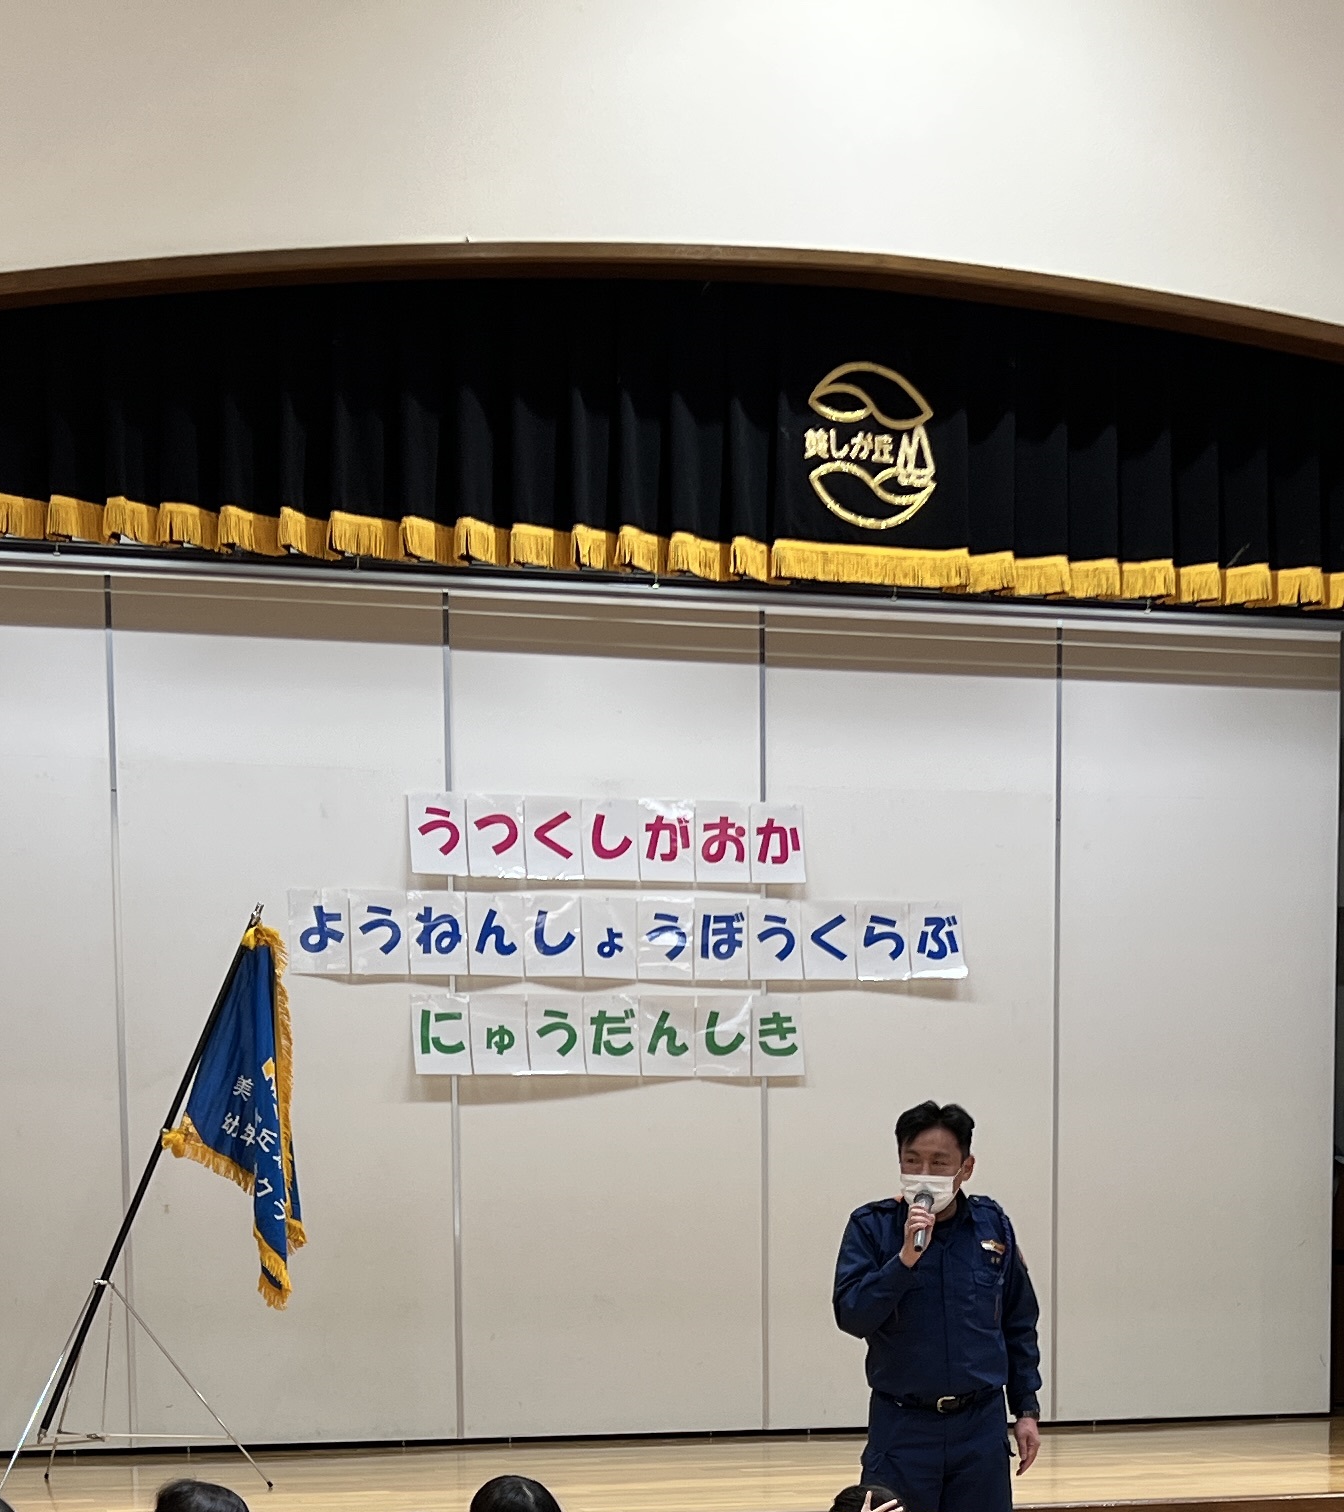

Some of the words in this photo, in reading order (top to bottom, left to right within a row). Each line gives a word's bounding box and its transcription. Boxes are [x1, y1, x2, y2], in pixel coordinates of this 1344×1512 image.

[417, 807, 802, 867] うつくしがおか
[298, 904, 962, 962] ようねんしょうぼうくらぶ
[420, 1006, 800, 1058] にゅうだんしき
